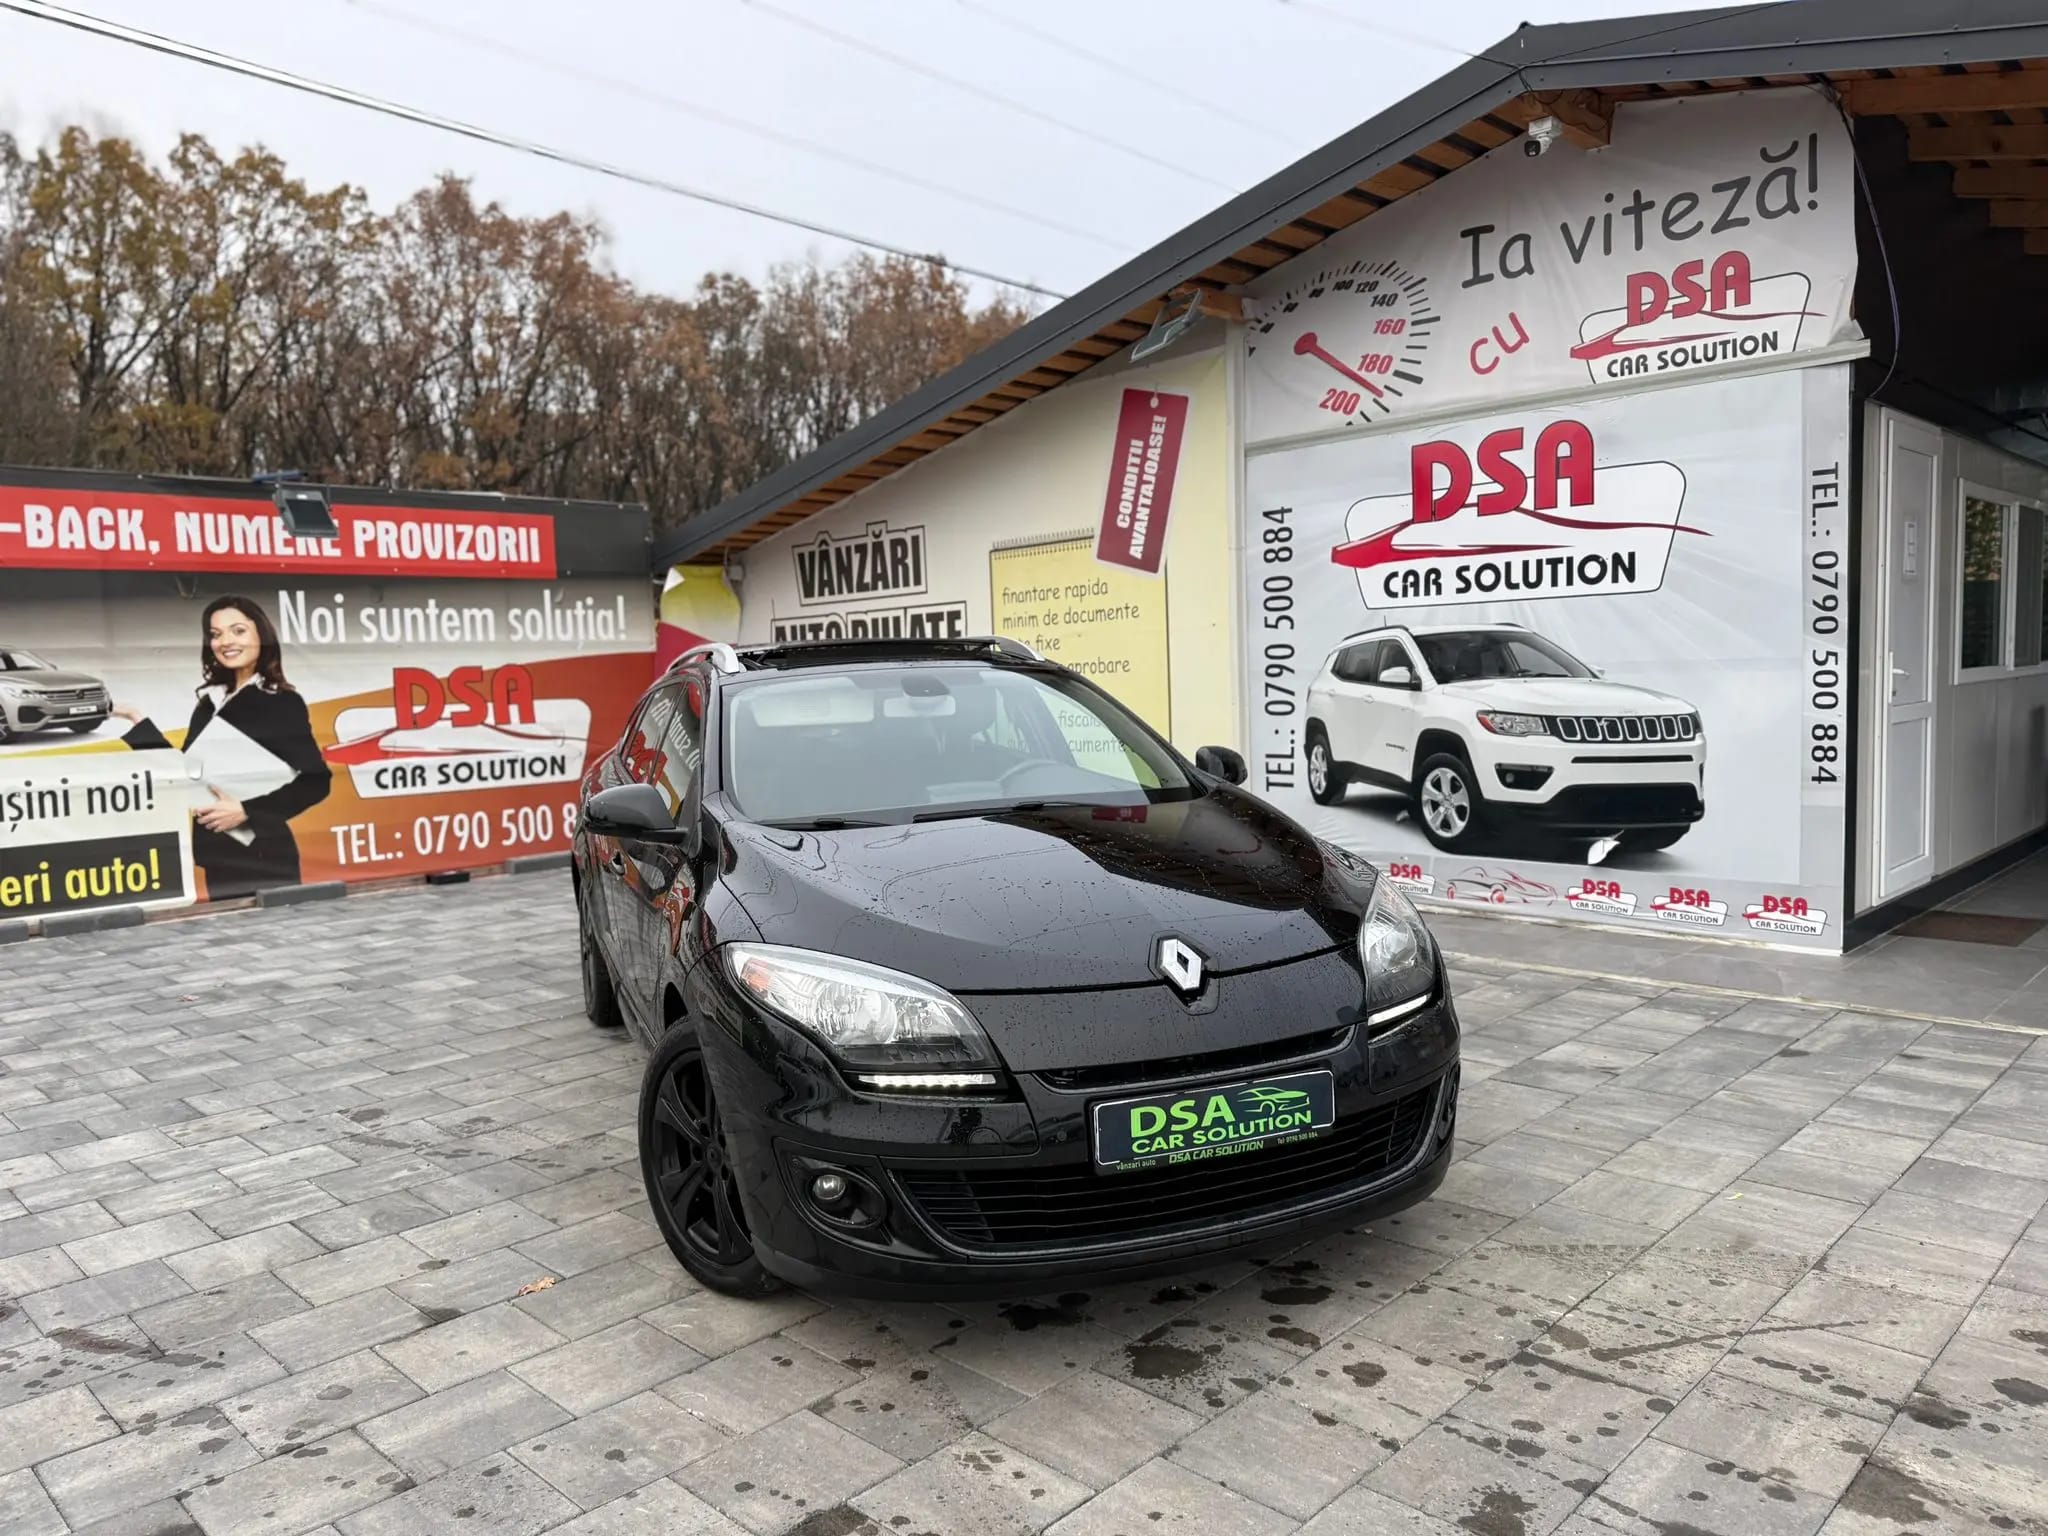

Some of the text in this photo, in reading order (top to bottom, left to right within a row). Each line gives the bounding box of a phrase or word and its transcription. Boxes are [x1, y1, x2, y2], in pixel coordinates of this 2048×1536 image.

[1460, 133, 1818, 288] Ia viteză!
[1355, 280, 1379, 293] 120
[1370, 293, 1398, 307] 140
[1627, 250, 1751, 328] DSA
[1373, 318, 1406, 335] 160
[1470, 312, 1529, 375] cu
[1357, 353, 1393, 374] 180
[1607, 331, 1778, 378] CAR SOLUTION
[1319, 388, 1360, 415] 200
[1116, 439, 1144, 529] CONDITII
[1129, 415, 1167, 560] AVANTAJOASE!
[1411, 419, 1594, 524] DSA
[353, 519, 540, 563] PROVIZORII
[1262, 505, 1294, 563] 884
[797, 528, 922, 599] VÂNZĂRI
[1383, 551, 1636, 599] CAR SOLUTION
[1002, 578, 1109, 606] finantare rapida
[1263, 575, 1294, 630] 500
[1811, 550, 1839, 635] 0790
[278, 589, 346, 644] Noi
[359, 598, 495, 643] suntem
[1002, 604, 1140, 629] minim de documente
[1036, 633, 1061, 652] fixe
[1067, 657, 1131, 675] aprobare
[1264, 643, 1296, 717] 0790
[1812, 649, 1839, 710] 500
[392, 663, 536, 730] DSA
[374, 755, 566, 789] CAR SOLUTION
[1811, 723, 1839, 784] 884
[0, 770, 154, 832] șini noi!
[330, 822, 404, 865] TEL.:
[413, 811, 490, 856] 0790
[502, 804, 552, 846] 500
[64, 848, 160, 899] auto!
[1390, 862, 1422, 879] DSA
[1582, 878, 1621, 898] DSA
[1575, 901, 1628, 915] CAR SOLUTION
[1662, 910, 1719, 924] CAR SOLUTION
[1669, 887, 1710, 908] DSA
[1763, 895, 1808, 916] DSA
[1755, 920, 1817, 934] CAR SOLUTION
[1130, 1094, 1235, 1138] DSA
[1131, 1110, 1312, 1154] CAR SOLUTION
[1169, 1140, 1264, 1164] DSA CAR SOLUTION
